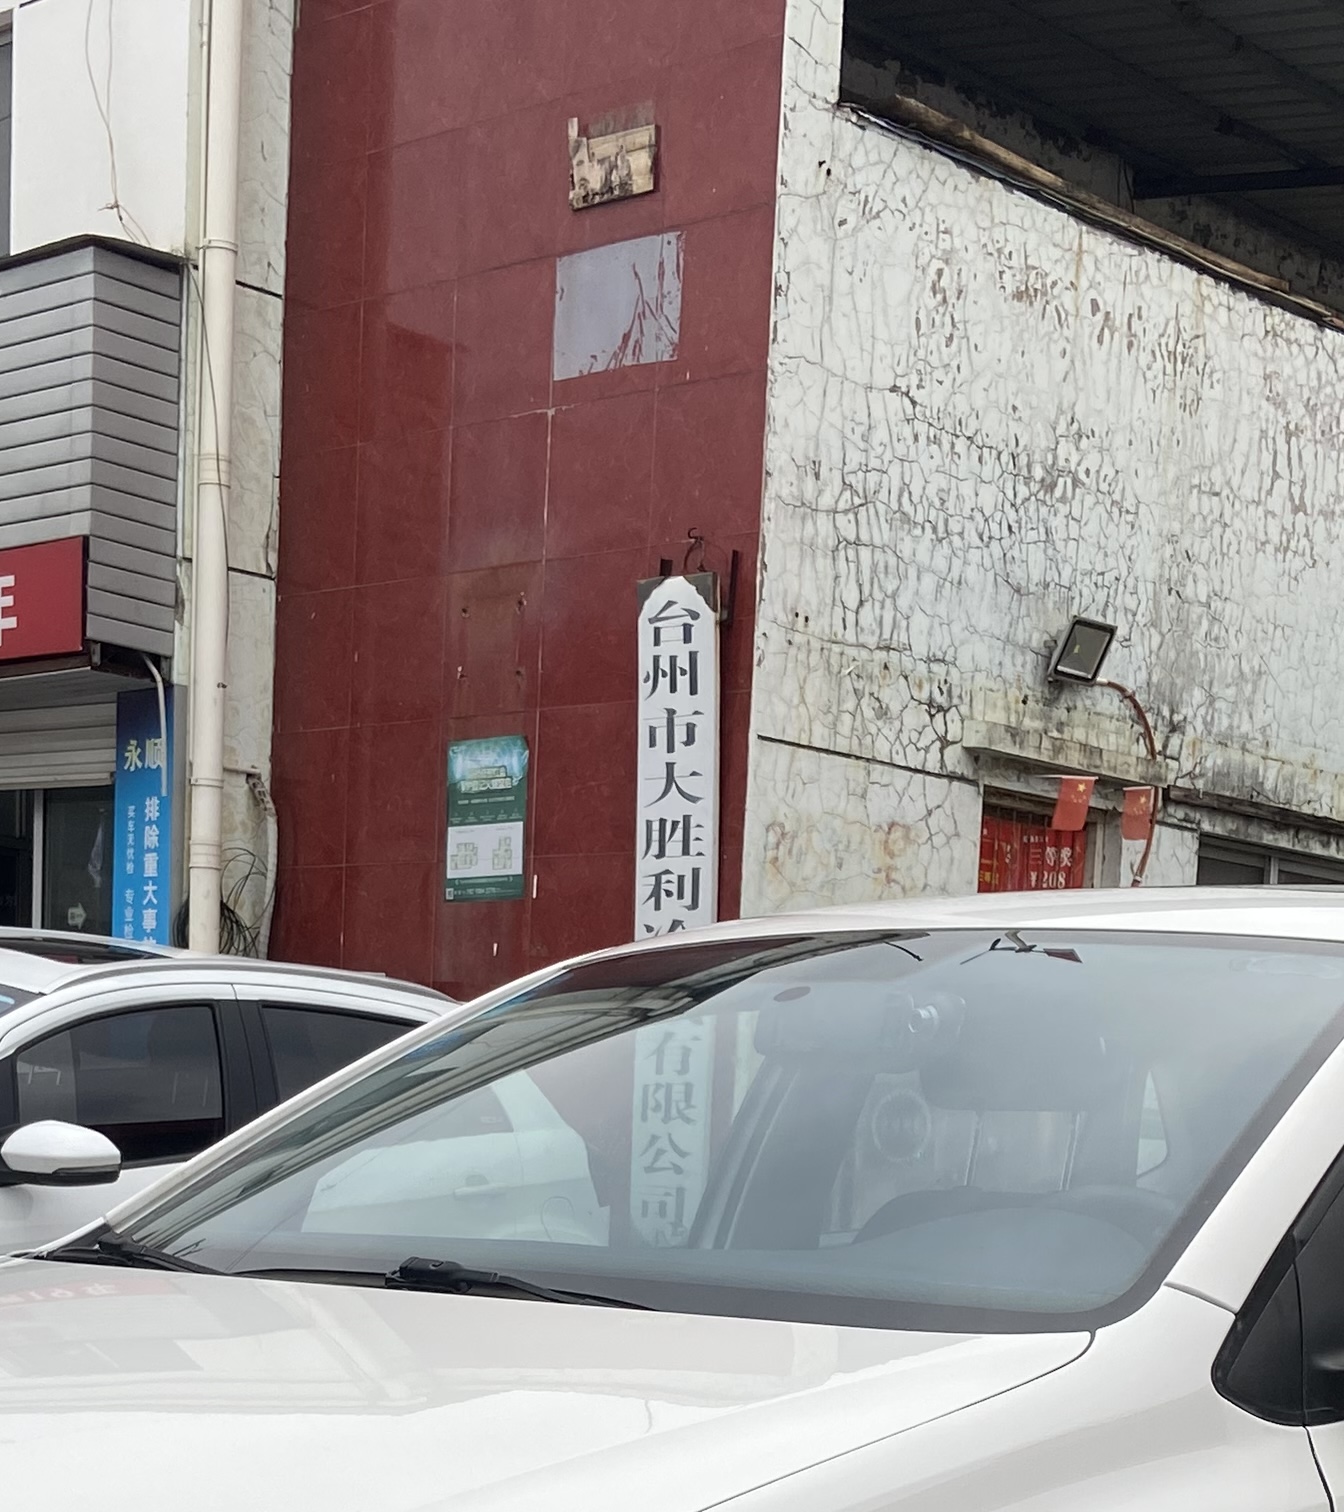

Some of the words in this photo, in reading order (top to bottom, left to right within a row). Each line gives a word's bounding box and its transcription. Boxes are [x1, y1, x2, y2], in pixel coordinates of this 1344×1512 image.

[123, 738, 165, 772] 永顺
[642, 599, 706, 936] 台州市大胜利
[142, 796, 161, 944] 排除重大事
